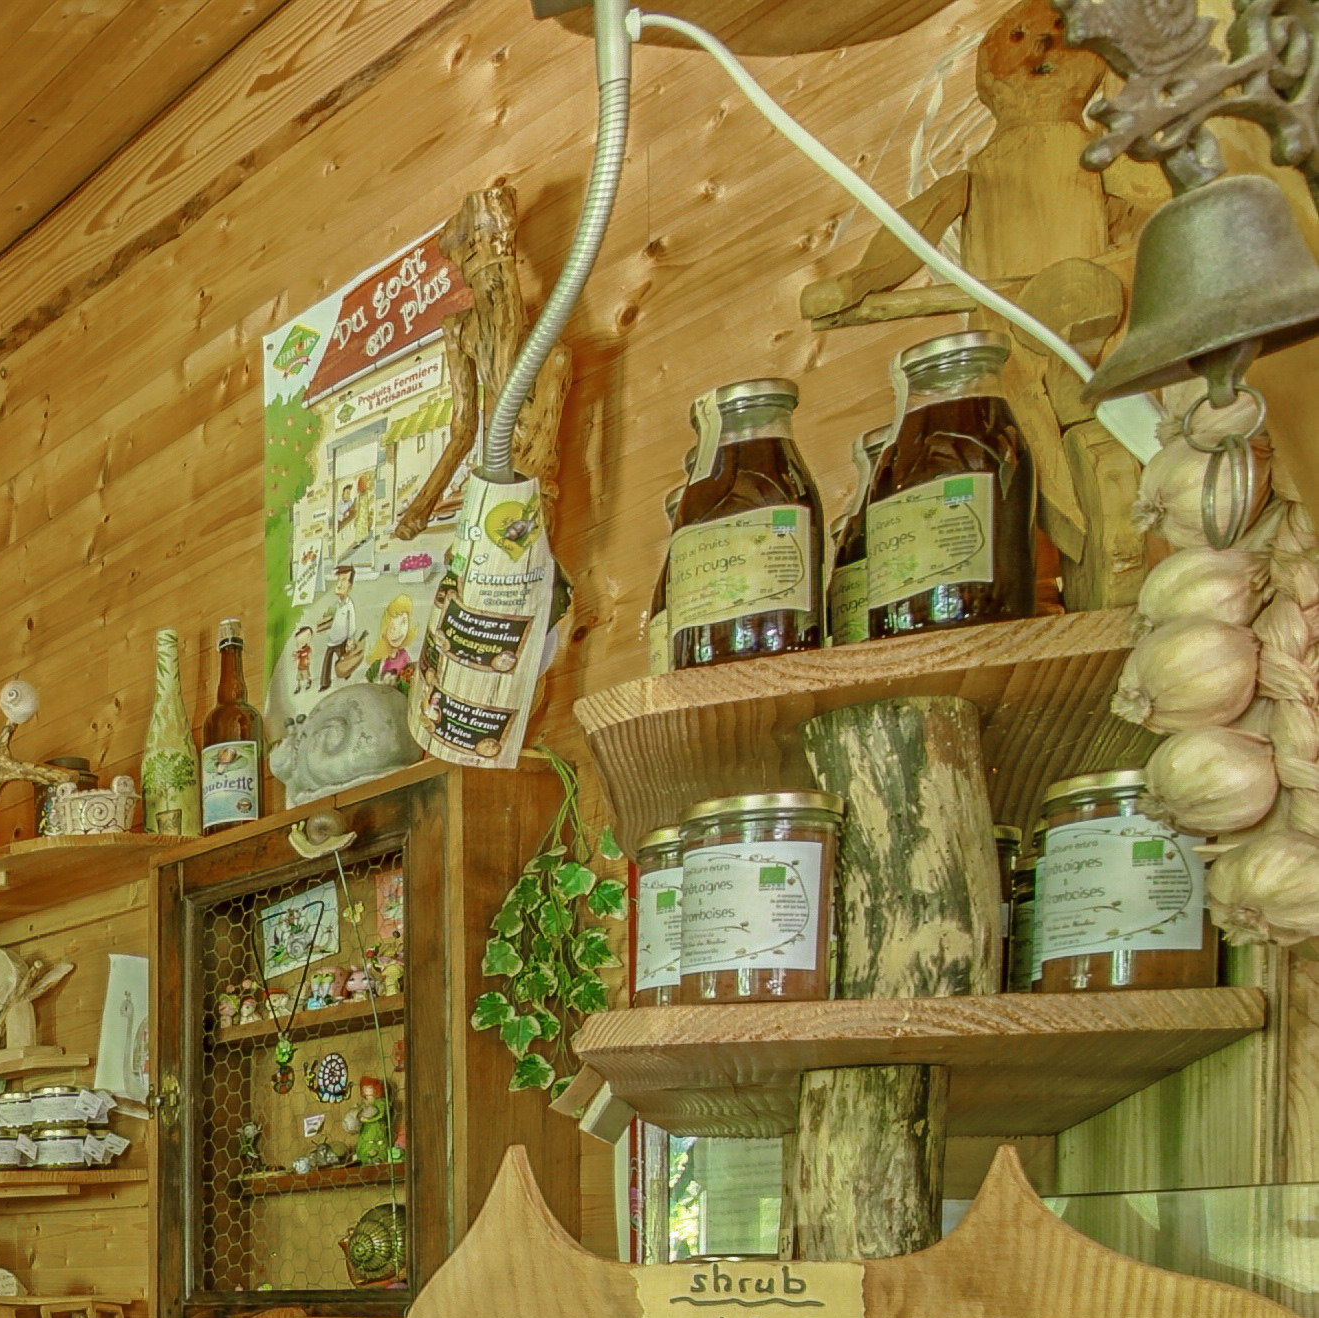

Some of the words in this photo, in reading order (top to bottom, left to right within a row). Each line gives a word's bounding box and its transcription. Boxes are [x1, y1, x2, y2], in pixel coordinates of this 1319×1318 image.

[363, 321, 397, 361] en
[398, 265, 453, 331] plus
[358, 382, 392, 406] Produits
[393, 362, 439, 389] Fermiers
[375, 382, 424, 408] Artisanaux
[874, 531, 916, 553] rouges
[468, 567, 545, 585] Fermanville
[695, 554, 747, 577] rouges
[447, 615, 520, 643] transformation
[458, 610, 498, 630] Elevage
[499, 621, 511, 630] et
[445, 629, 503, 654] d'escargots
[442, 708, 457, 719] sur
[458, 713, 468, 723] la
[469, 718, 500, 731] ferme
[445, 696, 471, 713] Vente
[471, 708, 507, 721] directe
[446, 722, 472, 739] Visites
[452, 736, 476, 750] ferme
[690, 1264, 808, 1296] shrub
